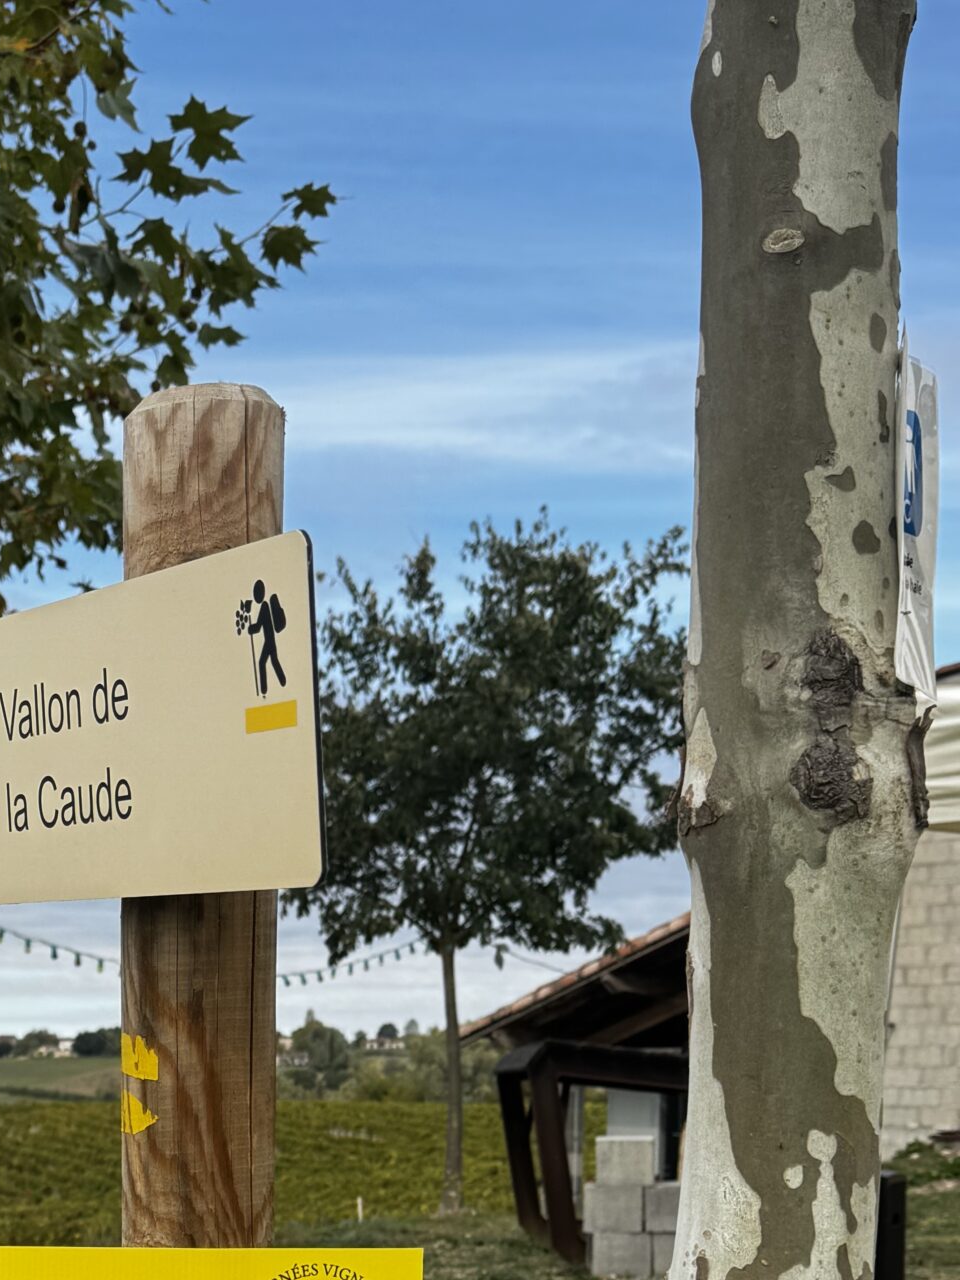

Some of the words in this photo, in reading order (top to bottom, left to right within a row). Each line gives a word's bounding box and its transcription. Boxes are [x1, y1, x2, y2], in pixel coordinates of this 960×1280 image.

[92, 667, 130, 725] de
[6, 782, 30, 833] la
[37, 766, 133, 829] Caude
